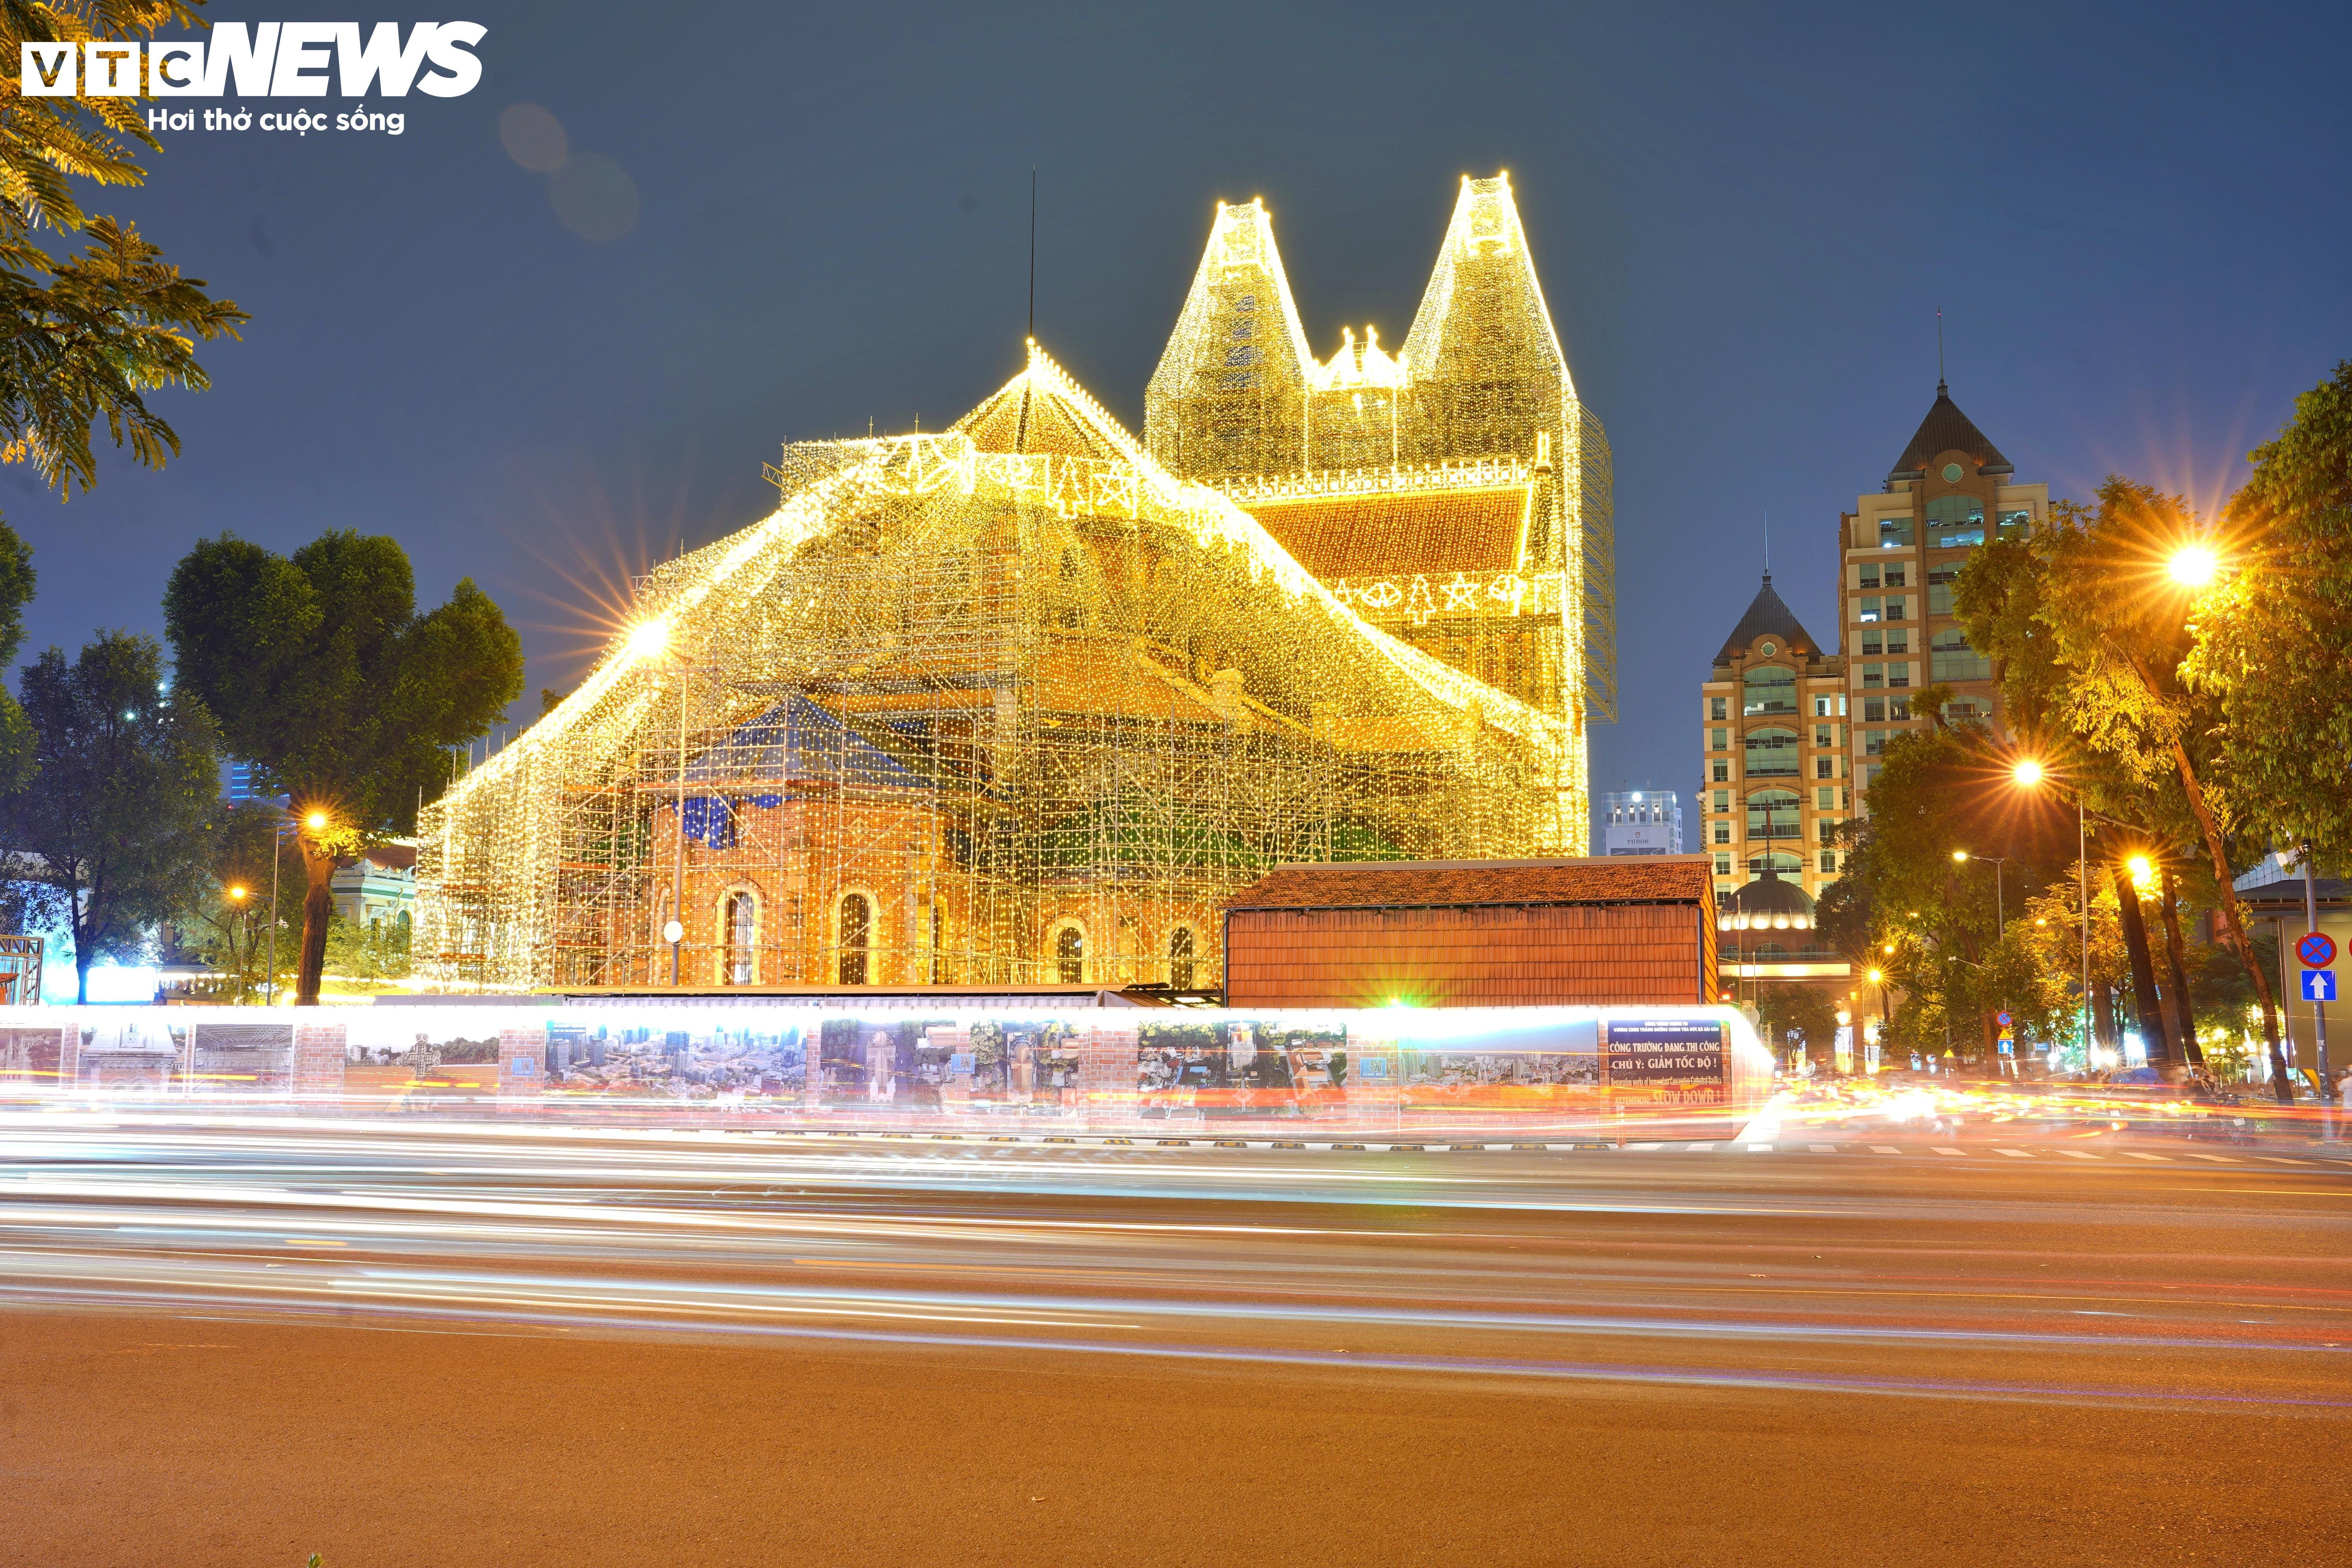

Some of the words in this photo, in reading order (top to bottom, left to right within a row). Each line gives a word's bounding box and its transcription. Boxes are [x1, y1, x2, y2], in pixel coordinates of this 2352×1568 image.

[1610, 1042, 1631, 1053] CÔNG
[1633, 1041, 1663, 1053] TRƯỜNG
[1664, 1042, 1684, 1052] ĐANG
[1686, 1042, 1697, 1052] THI
[1699, 1040, 1720, 1052] CÔNG
[1612, 1059, 1633, 1069] CHÚ
[1635, 1059, 1644, 1069] Ý:
[1648, 1055, 1673, 1069] GIẢM
[1675, 1054, 1695, 1068] TỐC
[1697, 1055, 1711, 1070] ĐỘ
[1713, 1058, 1717, 1068] !
[1611, 1077, 1632, 1086] Restoration
[1633, 1078, 1643, 1086] works
[1643, 1077, 1648, 1085] of
[1670, 1076, 1690, 1087] Conception
[1691, 1076, 1708, 1085] Cathedral
[1708, 1076, 1722, 1085] Basilica
[1615, 1096, 1651, 1106] ATTENTION:
[1653, 1090, 1680, 1105] SLOW
[1683, 1090, 1714, 1104] DOWN
